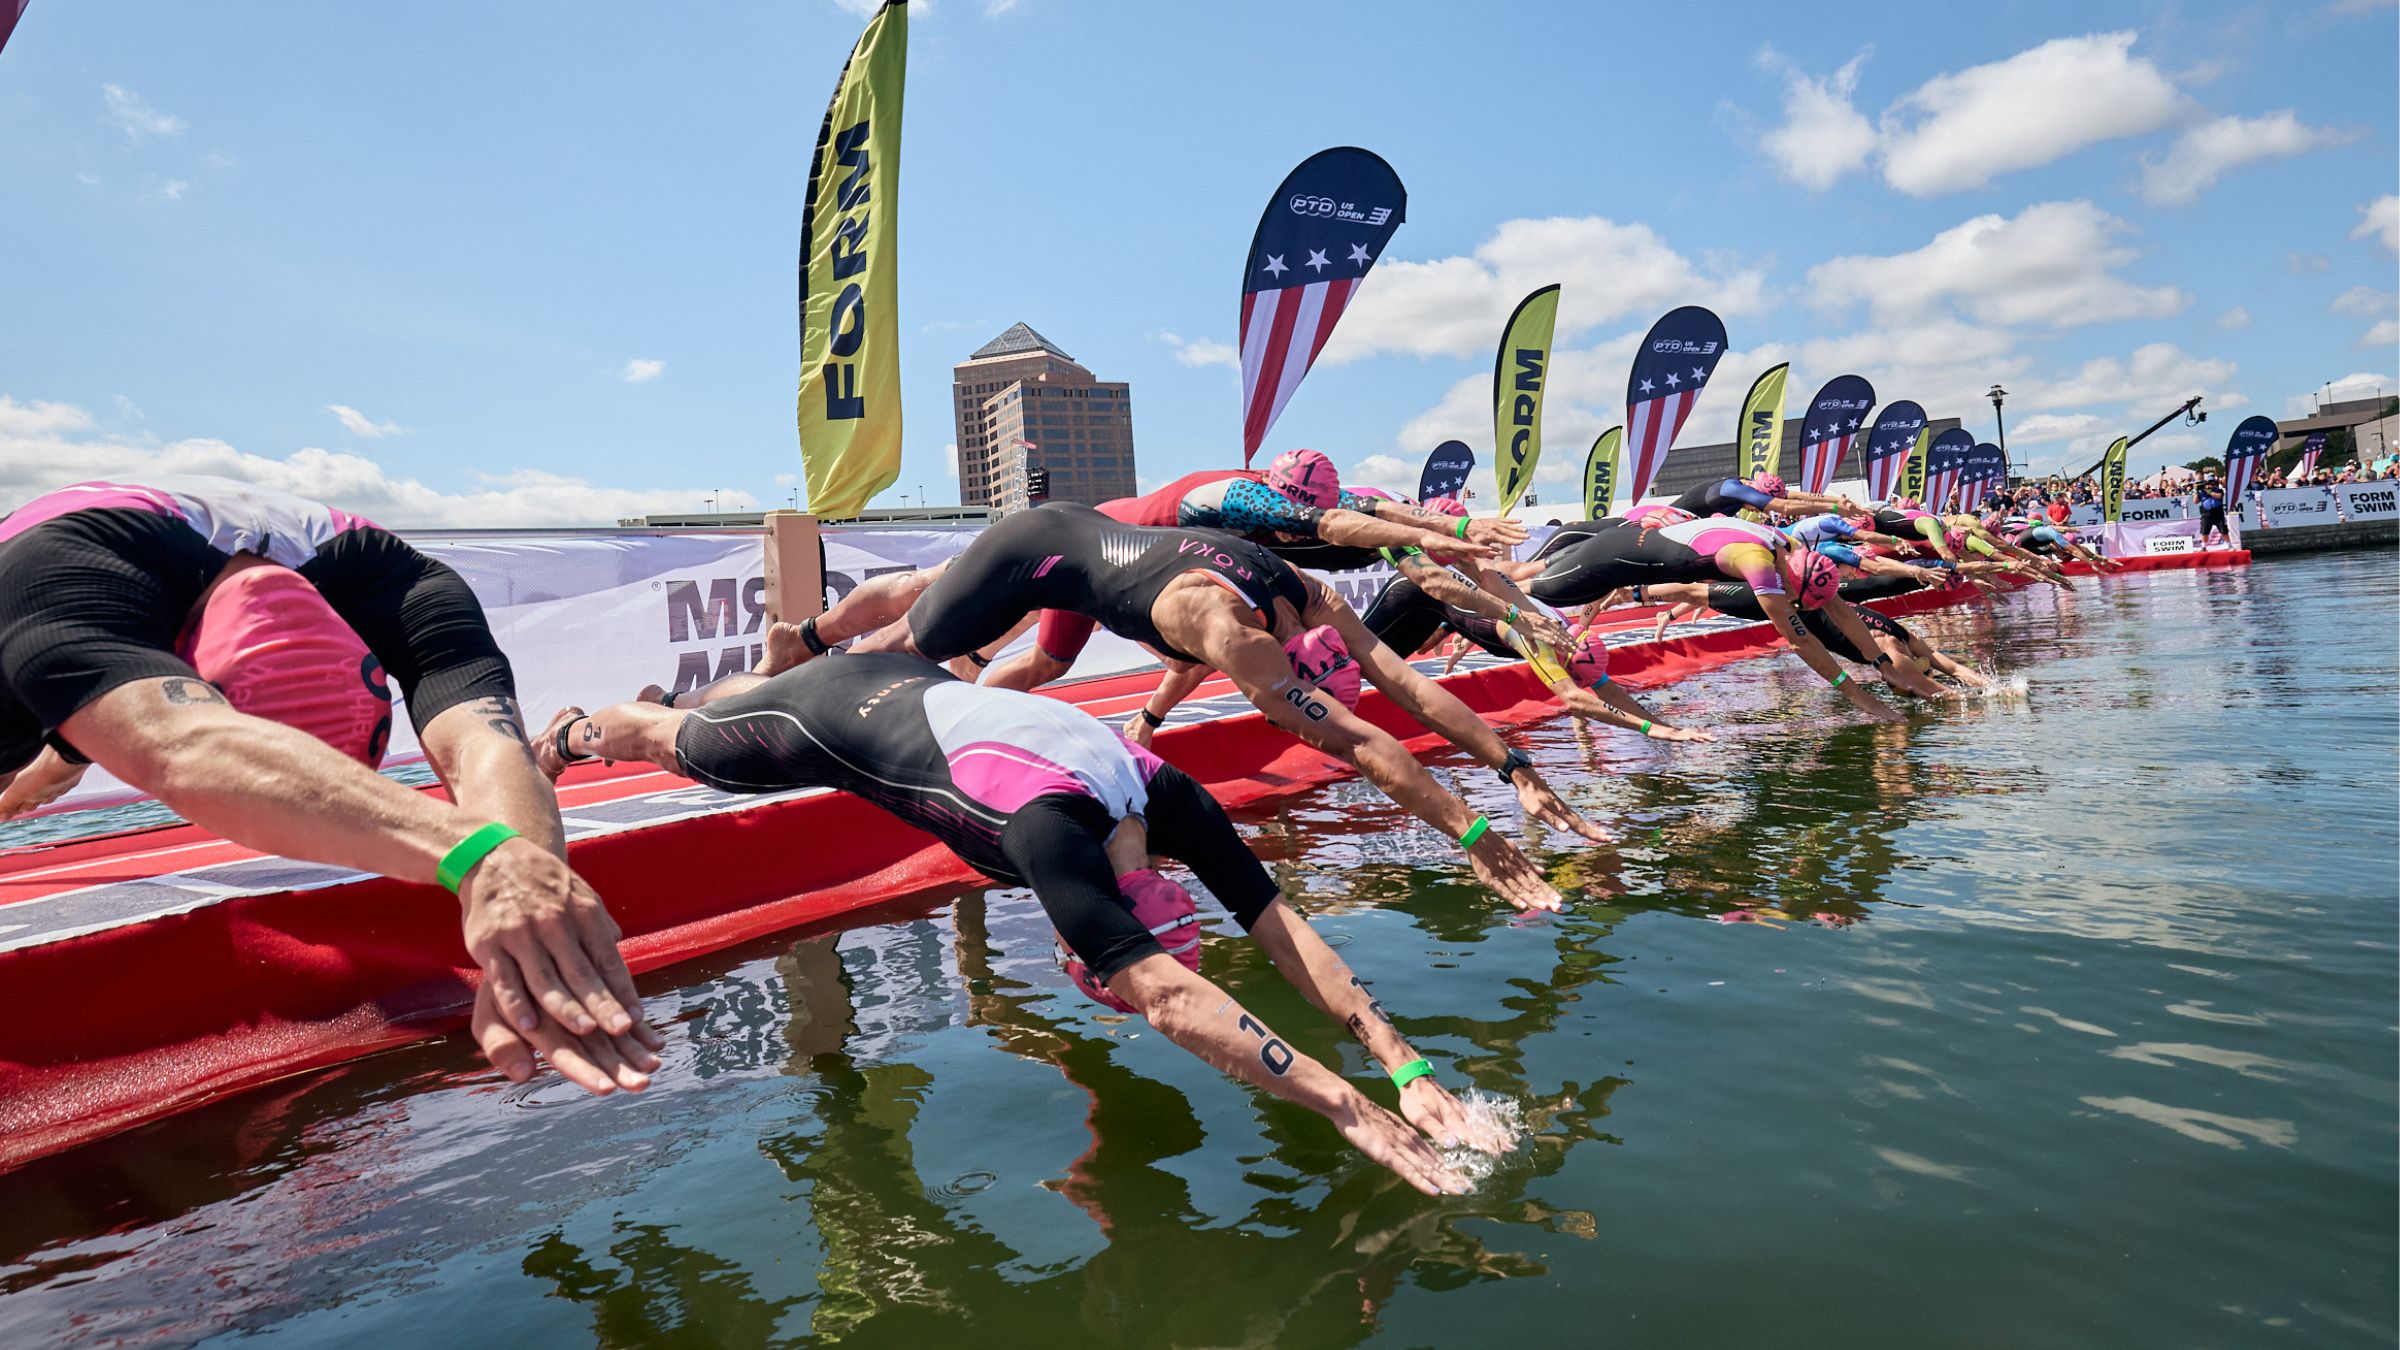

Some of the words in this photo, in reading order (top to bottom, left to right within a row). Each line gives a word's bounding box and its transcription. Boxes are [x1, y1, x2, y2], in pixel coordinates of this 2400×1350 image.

[1292, 197, 1334, 214] PTO
[1341, 202, 1354, 210] US
[1337, 210, 1364, 220] OPEN
[823, 119, 871, 420] FORM
[1654, 341, 1681, 351] PTO
[1820, 400, 1840, 408] PTO
[1270, 473, 1316, 505] FORM
[1592, 461, 1611, 520] ORM
[2110, 461, 2123, 514] FORM
[2350, 491, 2395, 503] FORM
[2273, 504, 2296, 513] PTO
[2354, 502, 2396, 513] SWIM
[2122, 509, 2170, 522] FORM
[1286, 687, 1328, 721] 20
[1238, 1013, 1295, 1077] 10
